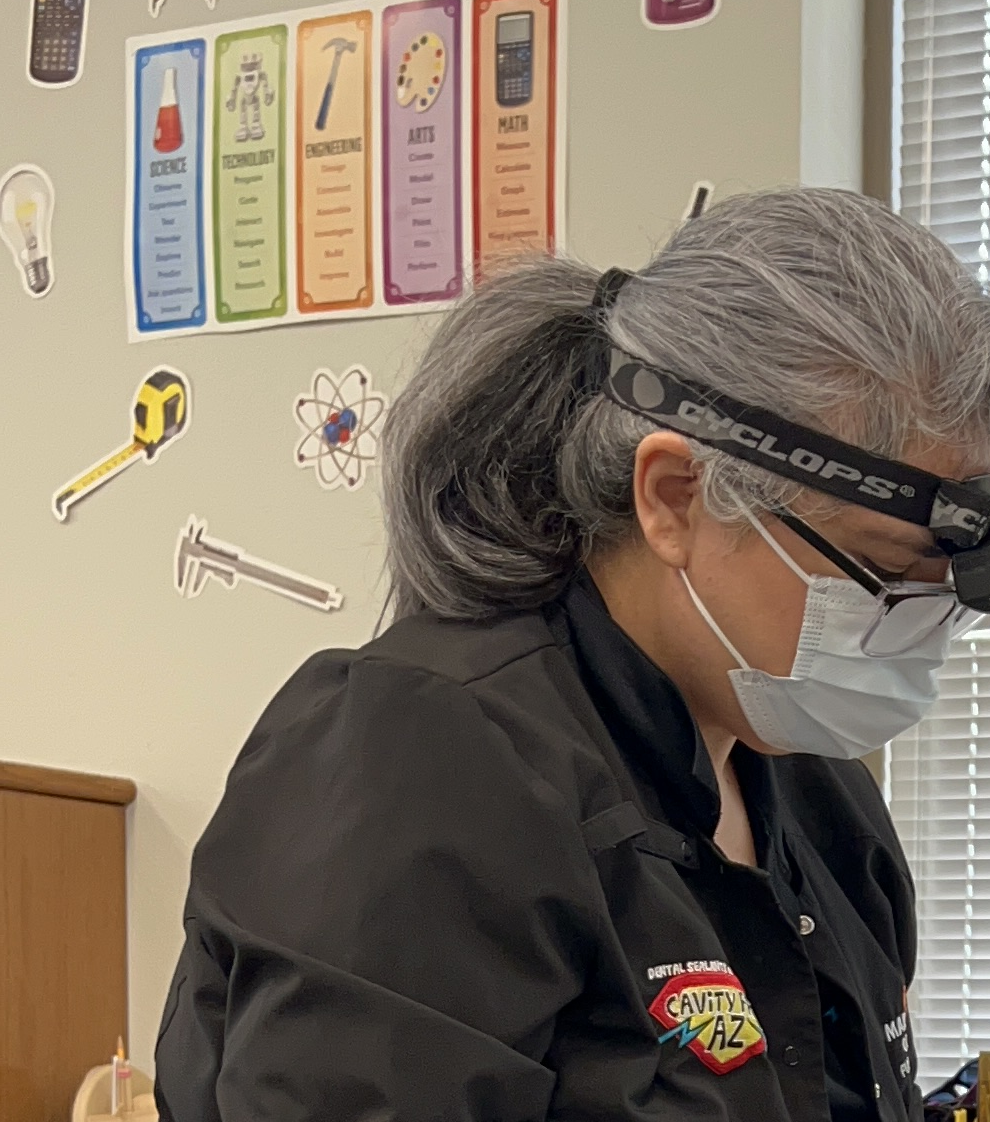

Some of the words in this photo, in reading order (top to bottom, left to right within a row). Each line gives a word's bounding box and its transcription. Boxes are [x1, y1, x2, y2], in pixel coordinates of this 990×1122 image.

[497, 114, 529, 134] MATH
[407, 125, 436, 146] ARTS
[150, 156, 187, 178] SCIENCE
[222, 148, 275, 170] TECHNOLOGY
[647, 963, 686, 980] DENTAL
[707, 1014, 744, 1051] AZ
